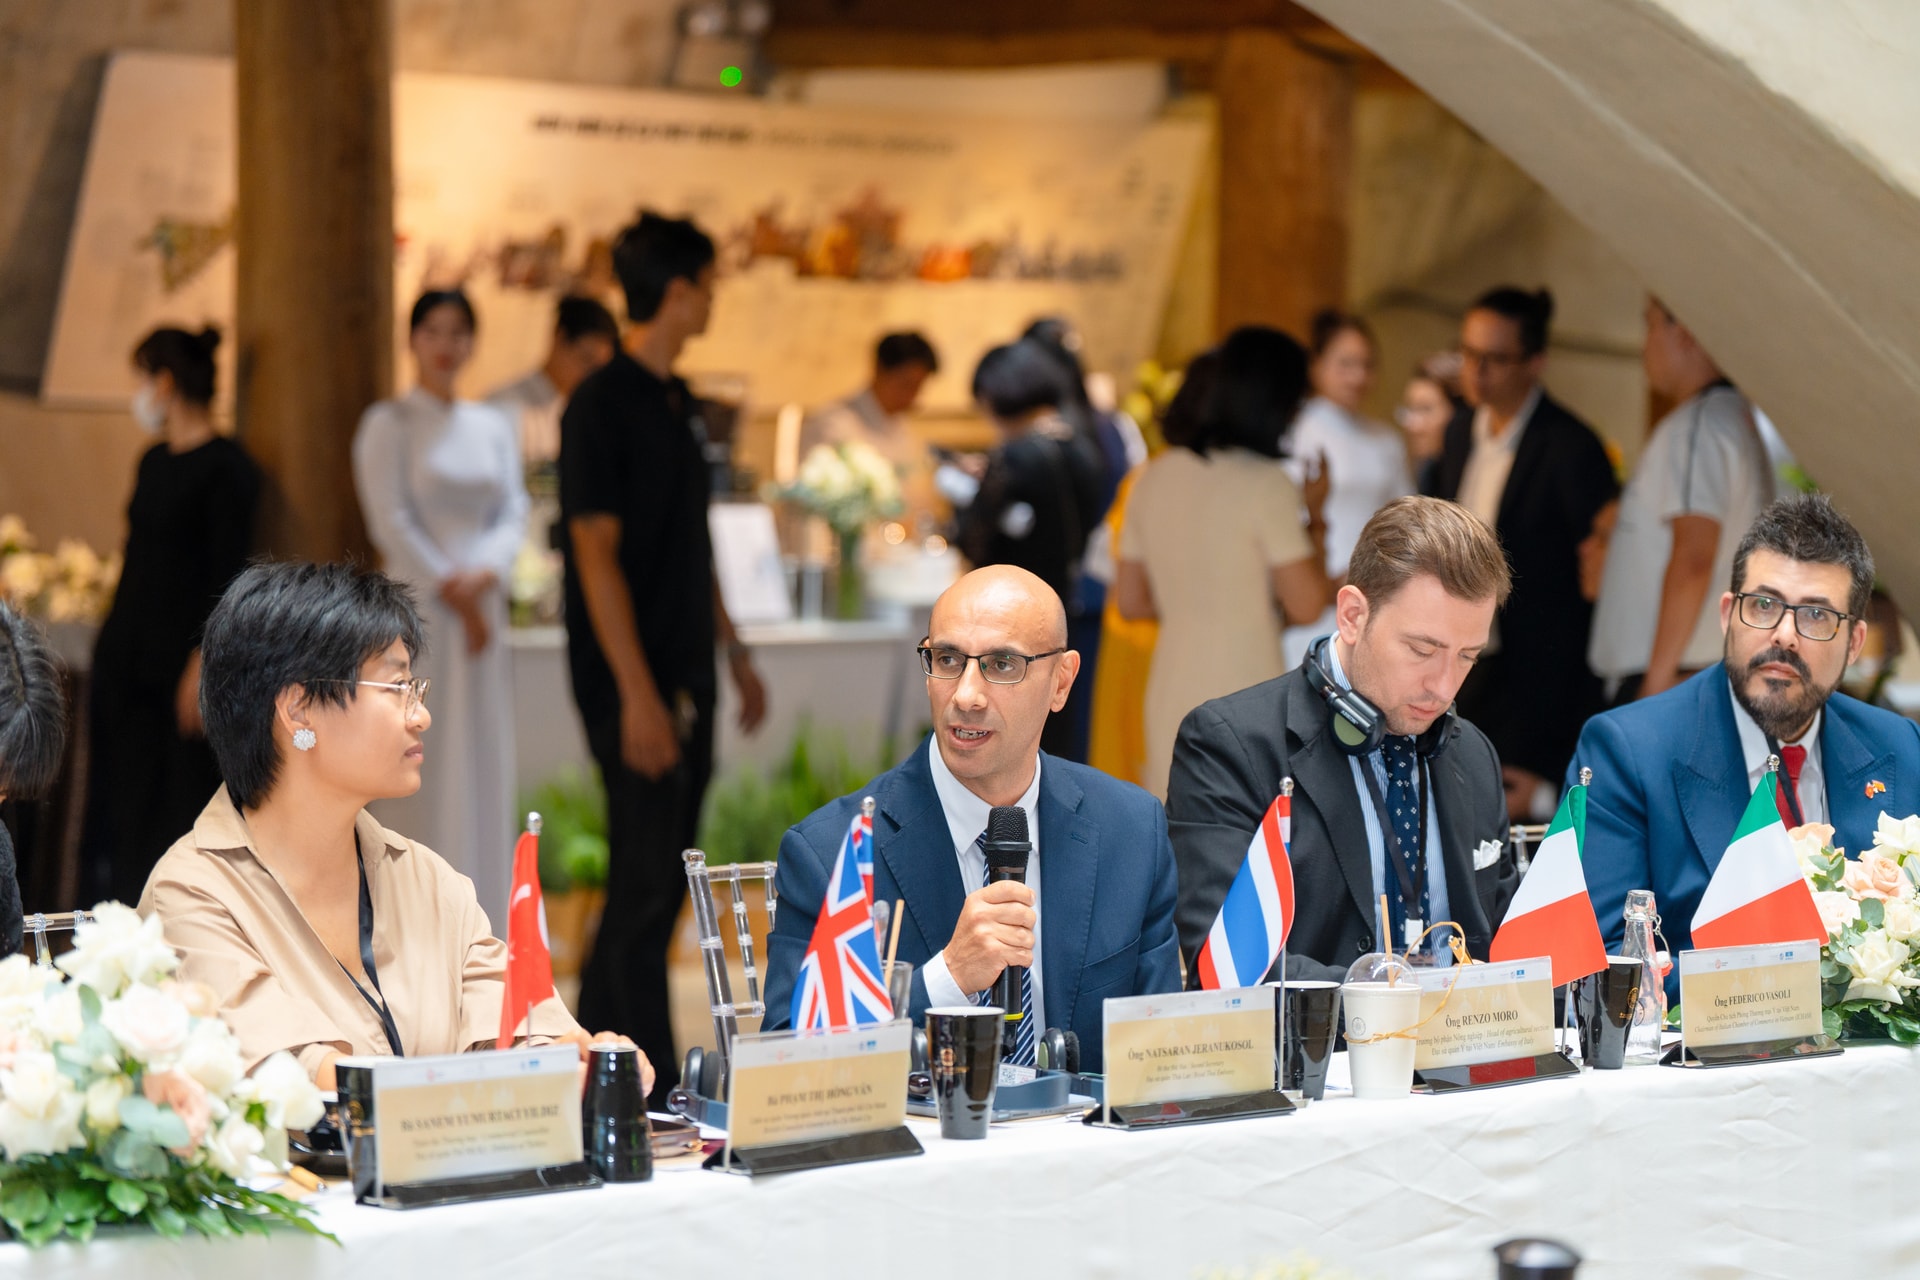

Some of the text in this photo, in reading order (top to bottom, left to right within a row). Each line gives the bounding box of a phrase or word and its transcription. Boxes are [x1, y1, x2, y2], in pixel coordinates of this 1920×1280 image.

[1714, 989, 1791, 1008] Ông FEDERICO VASOLI
[1445, 1010, 1518, 1029] Ông RENZO MORO
[1145, 1045, 1191, 1058] NATSARAN
[1192, 1039, 1254, 1055] JERANUKOSOL
